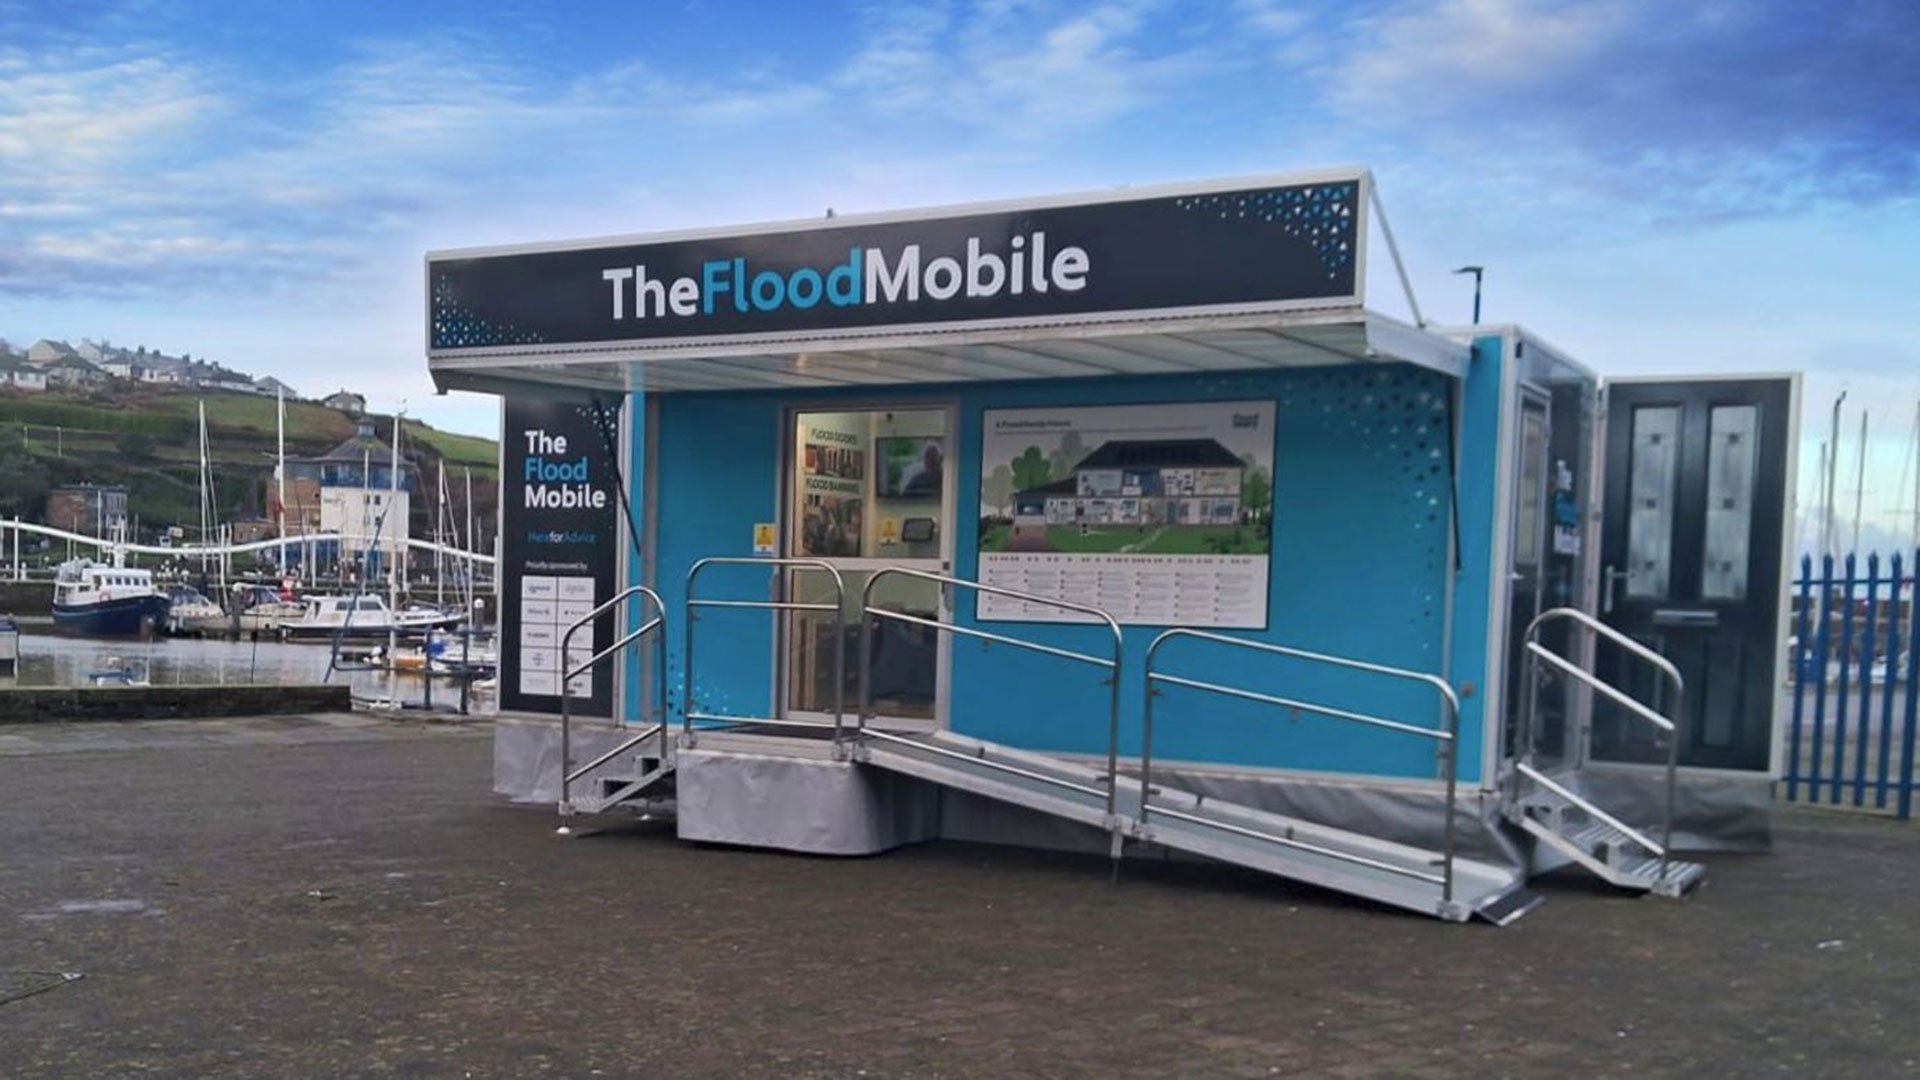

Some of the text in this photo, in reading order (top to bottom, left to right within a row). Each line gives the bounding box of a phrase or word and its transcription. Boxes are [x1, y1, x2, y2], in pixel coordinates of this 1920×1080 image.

[602, 231, 1090, 320] TheFloodMobile
[524, 430, 567, 454] The
[524, 457, 588, 482] Flood
[524, 484, 606, 509] Mobile
